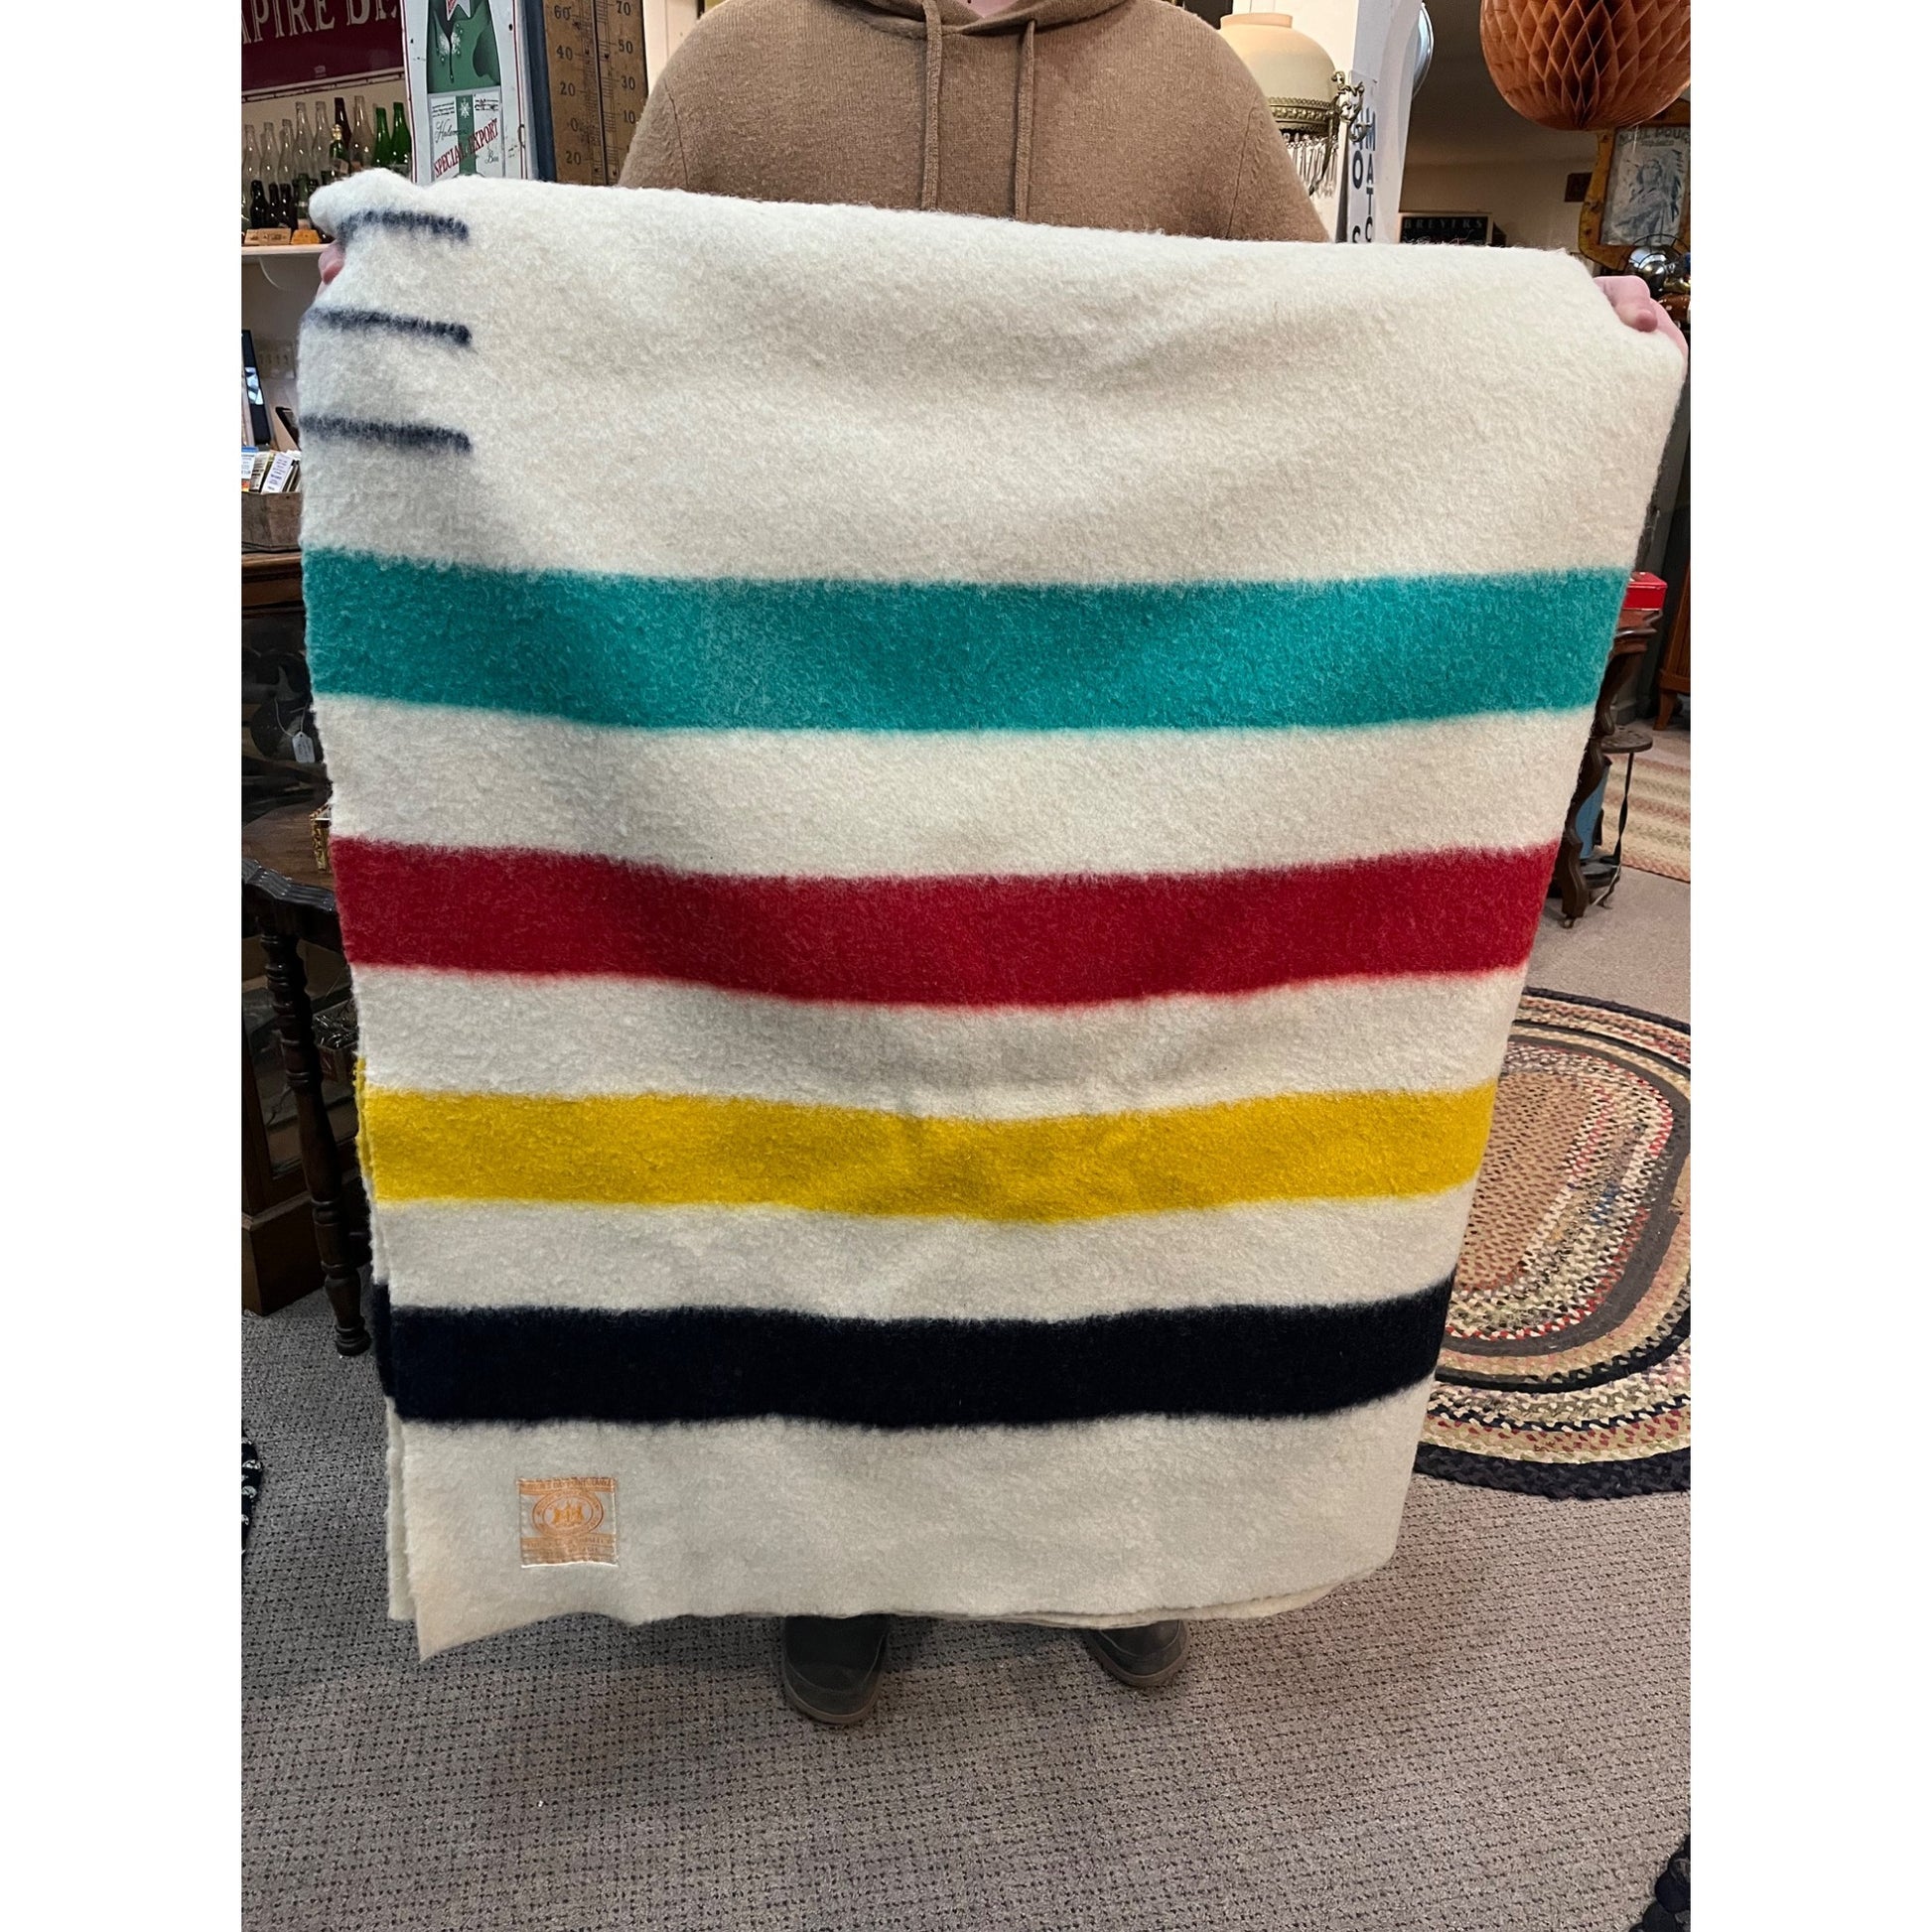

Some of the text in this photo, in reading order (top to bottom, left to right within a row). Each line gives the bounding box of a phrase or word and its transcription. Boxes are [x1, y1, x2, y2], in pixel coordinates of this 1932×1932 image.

[554, 5, 571, 20] 60
[617, 1, 630, 16] 70
[556, 45, 573, 61] 40
[619, 39, 633, 54] 50
[560, 81, 576, 96] 20
[621, 75, 635, 90] 30
[623, 110, 635, 124] 10
[434, 141, 469, 179] SPECIAL
[468, 118, 498, 154] EXPORT
[565, 150, 582, 165] 20
